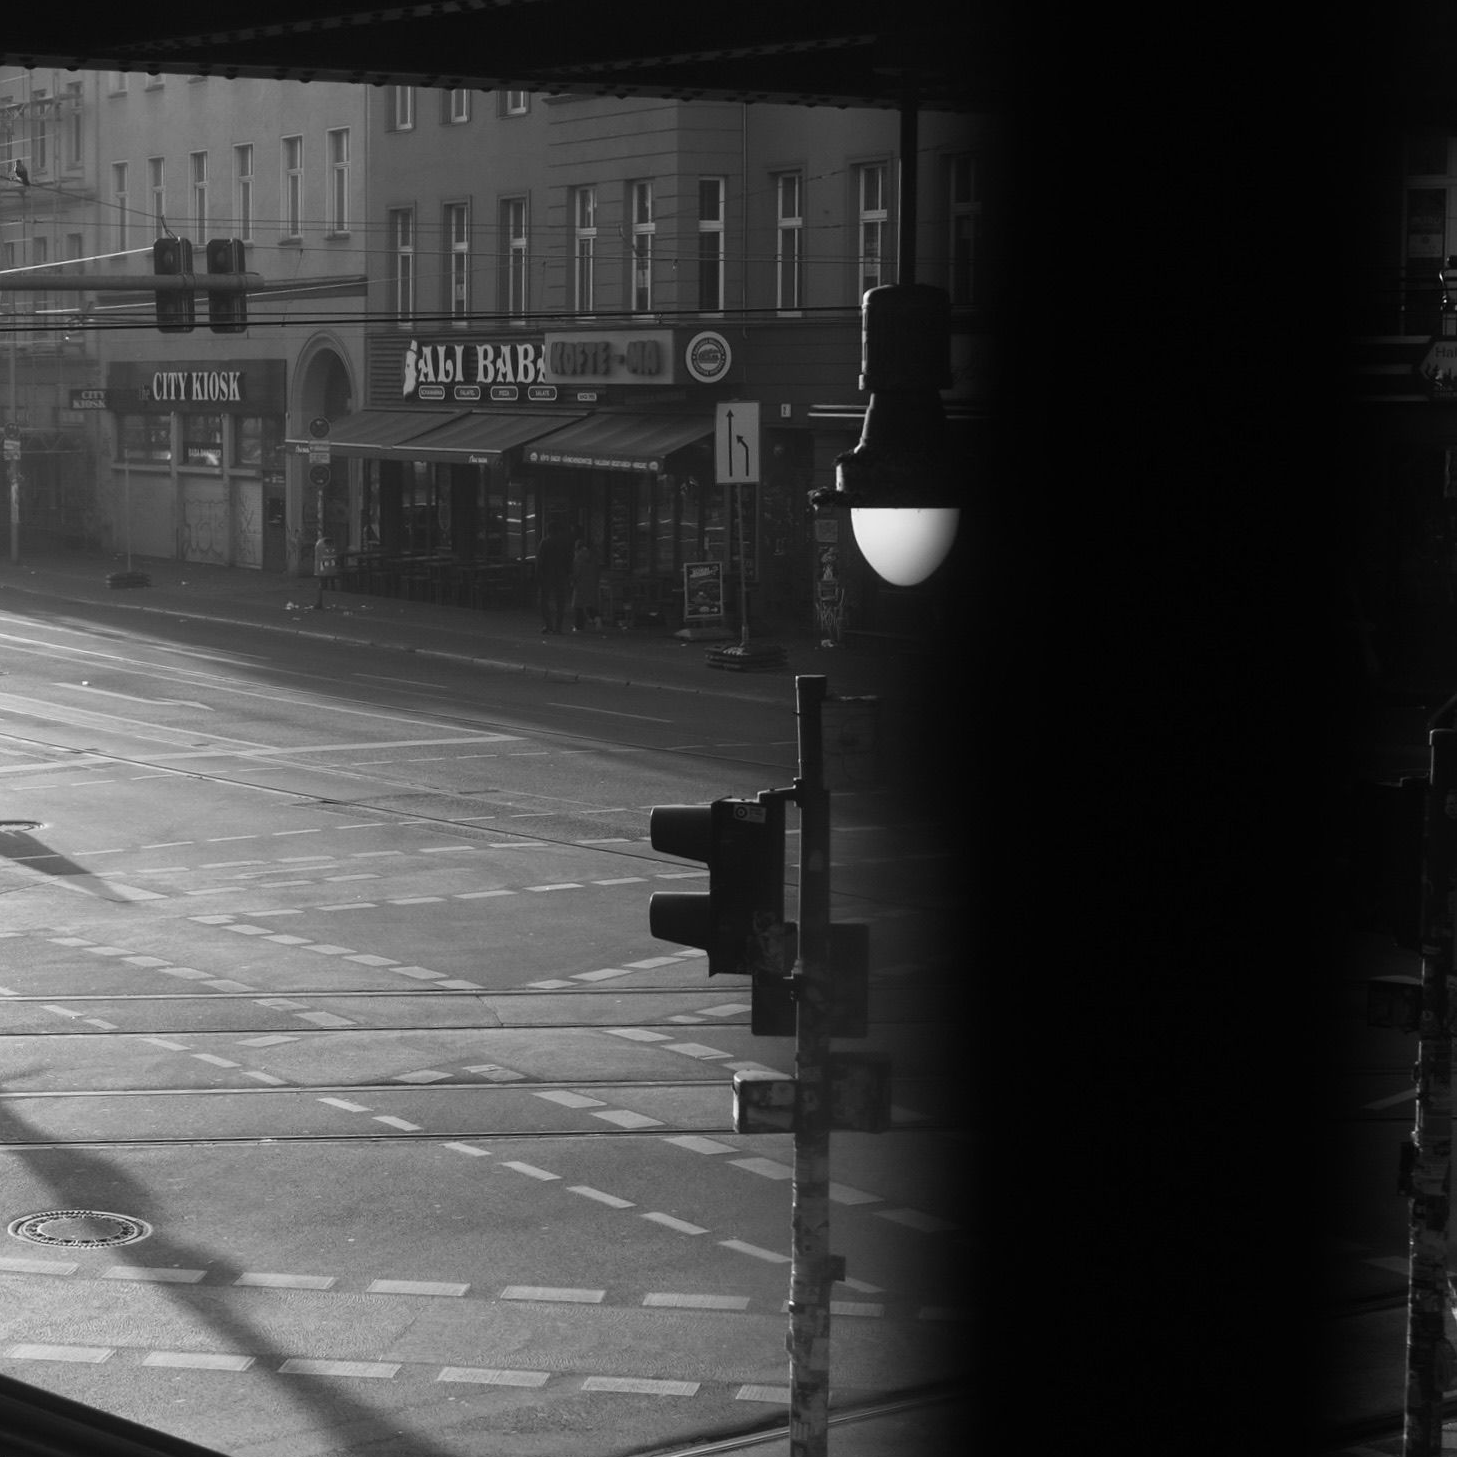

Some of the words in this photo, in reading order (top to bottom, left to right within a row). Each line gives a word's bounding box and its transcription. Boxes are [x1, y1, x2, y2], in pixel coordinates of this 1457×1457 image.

[417, 344, 465, 383] ALI
[80, 390, 107, 400] CITY
[152, 371, 189, 402] CITY
[191, 371, 242, 402] KIOSK
[72, 399, 107, 410] KIOSK
